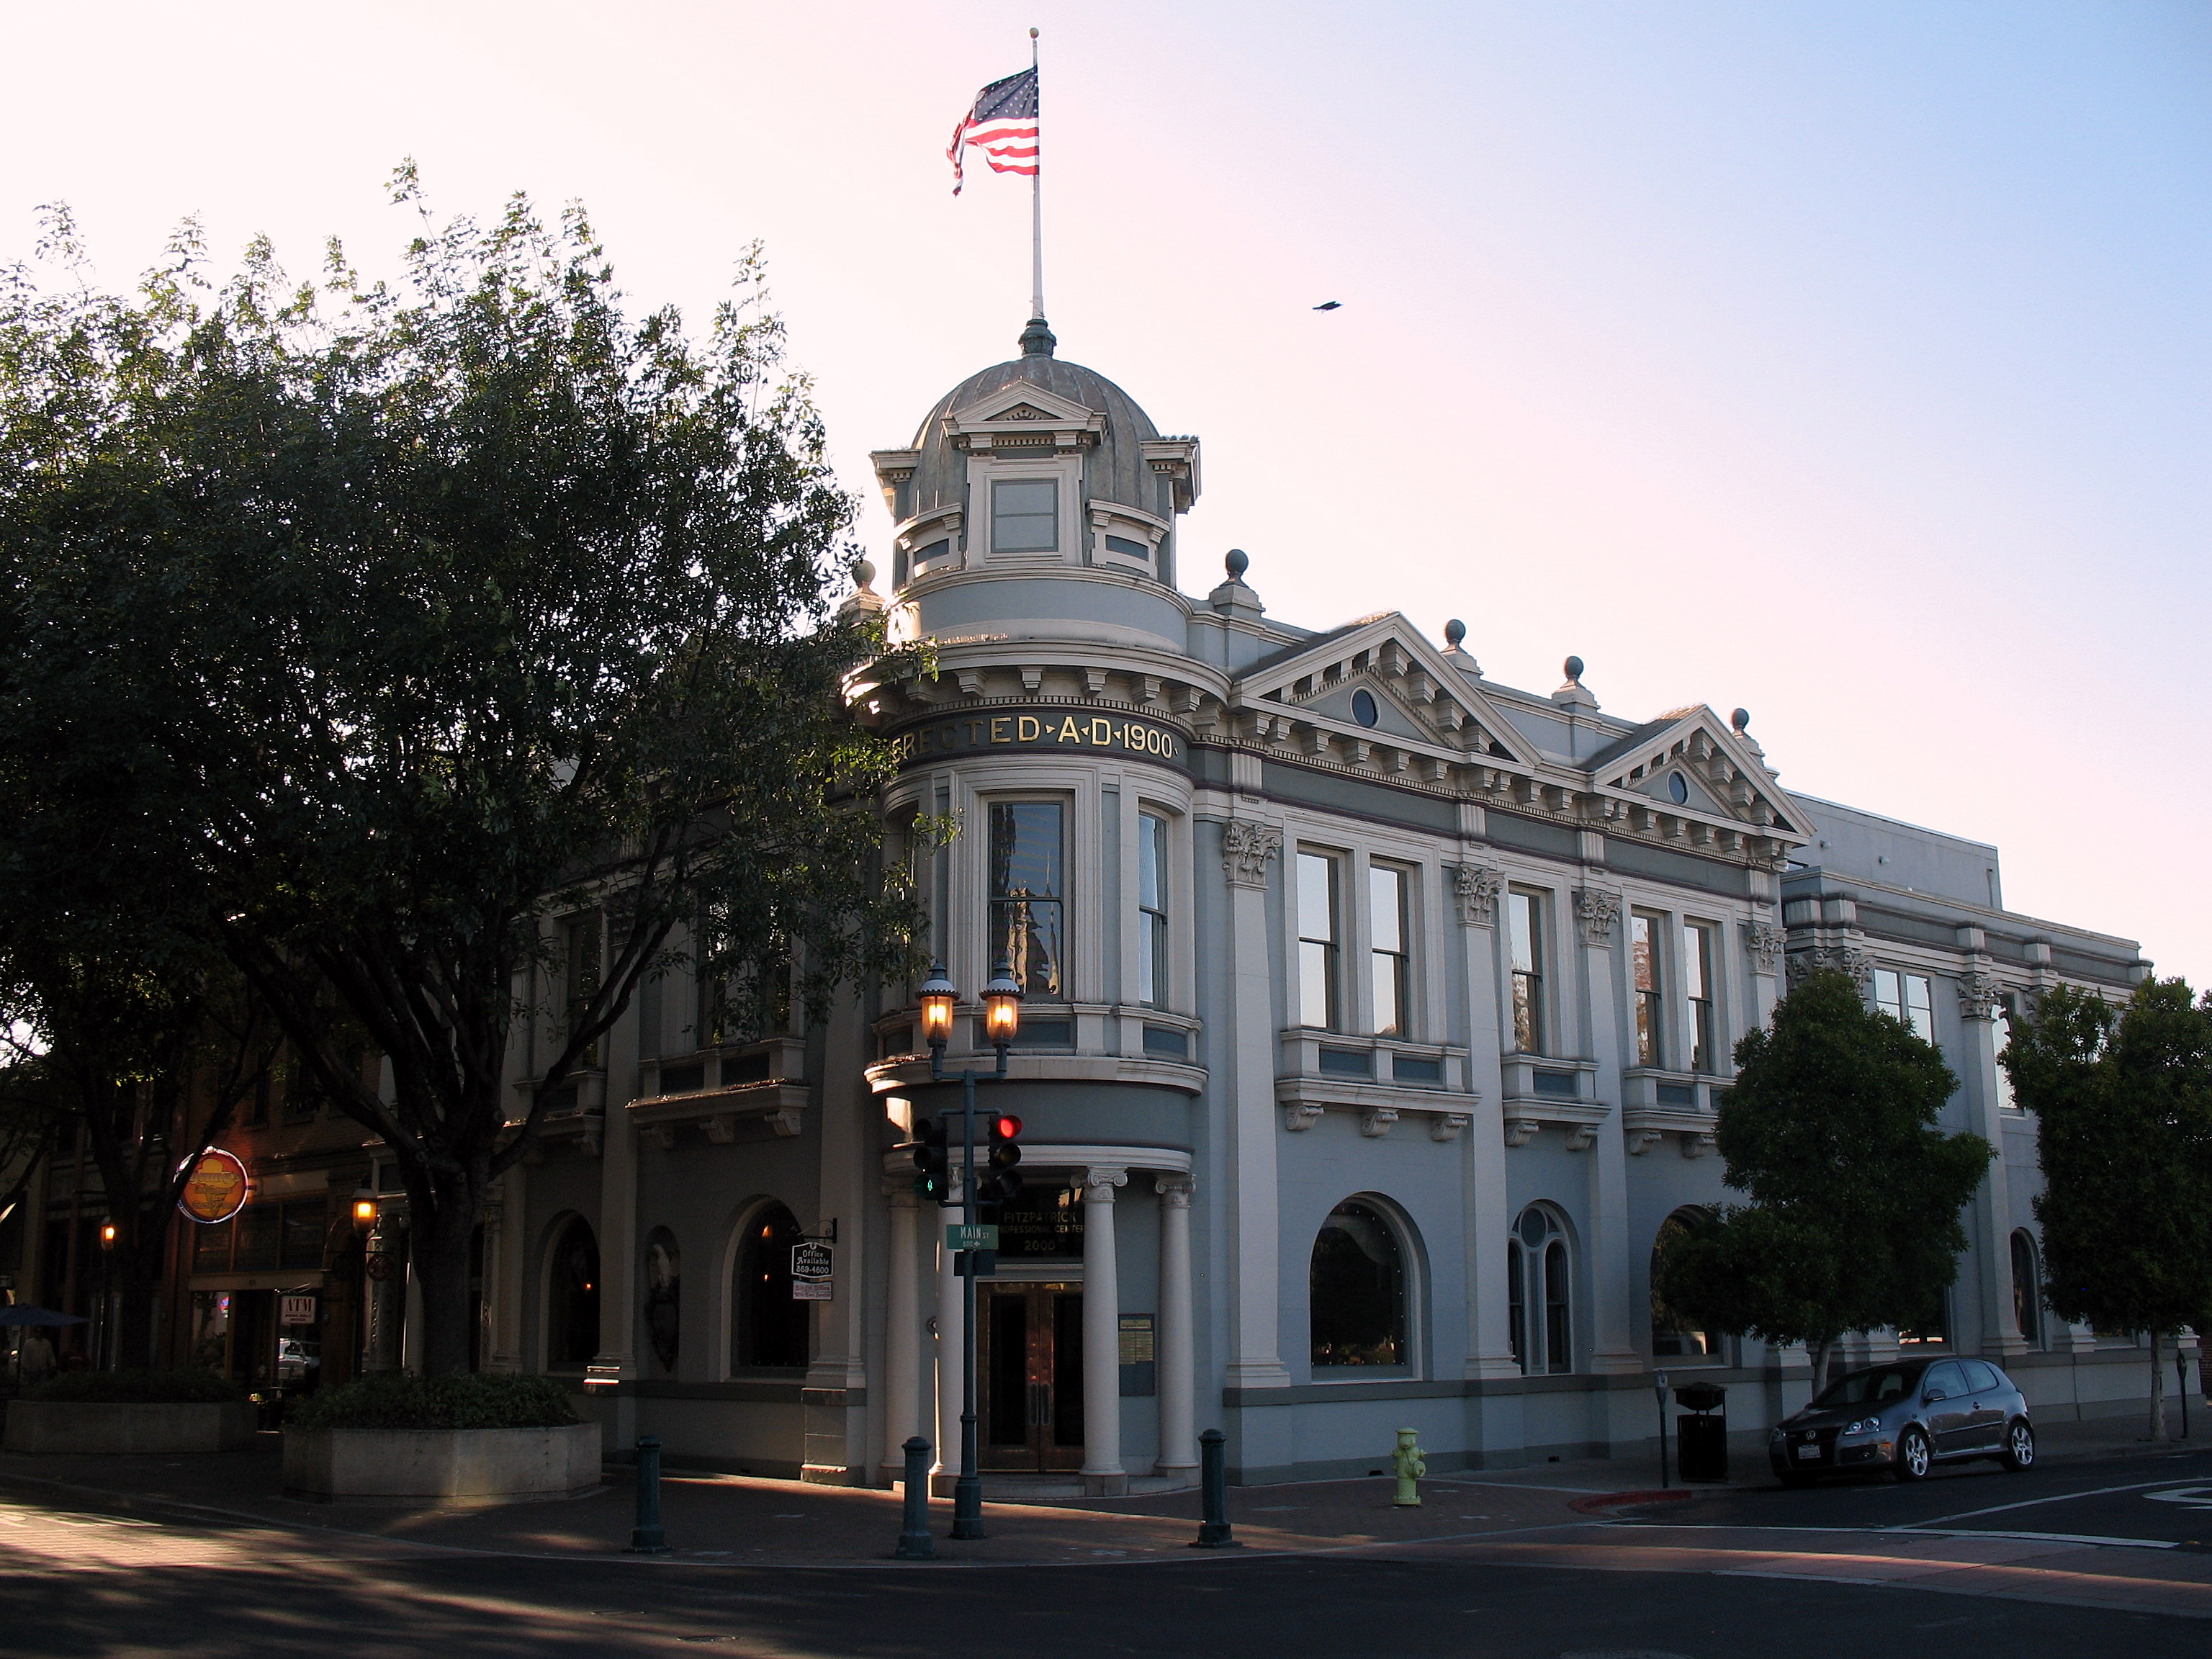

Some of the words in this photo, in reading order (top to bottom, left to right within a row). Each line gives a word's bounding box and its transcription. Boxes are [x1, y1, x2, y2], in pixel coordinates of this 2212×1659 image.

[891, 716, 1040, 764] ERECTED
[1123, 723, 1173, 759] 1900
[1004, 1211, 1077, 1223] FITZPATRICK
[960, 1226, 981, 1239] MAIN
[1024, 1240, 1056, 1251] 2000
[287, 1298, 312, 1312] ATM
